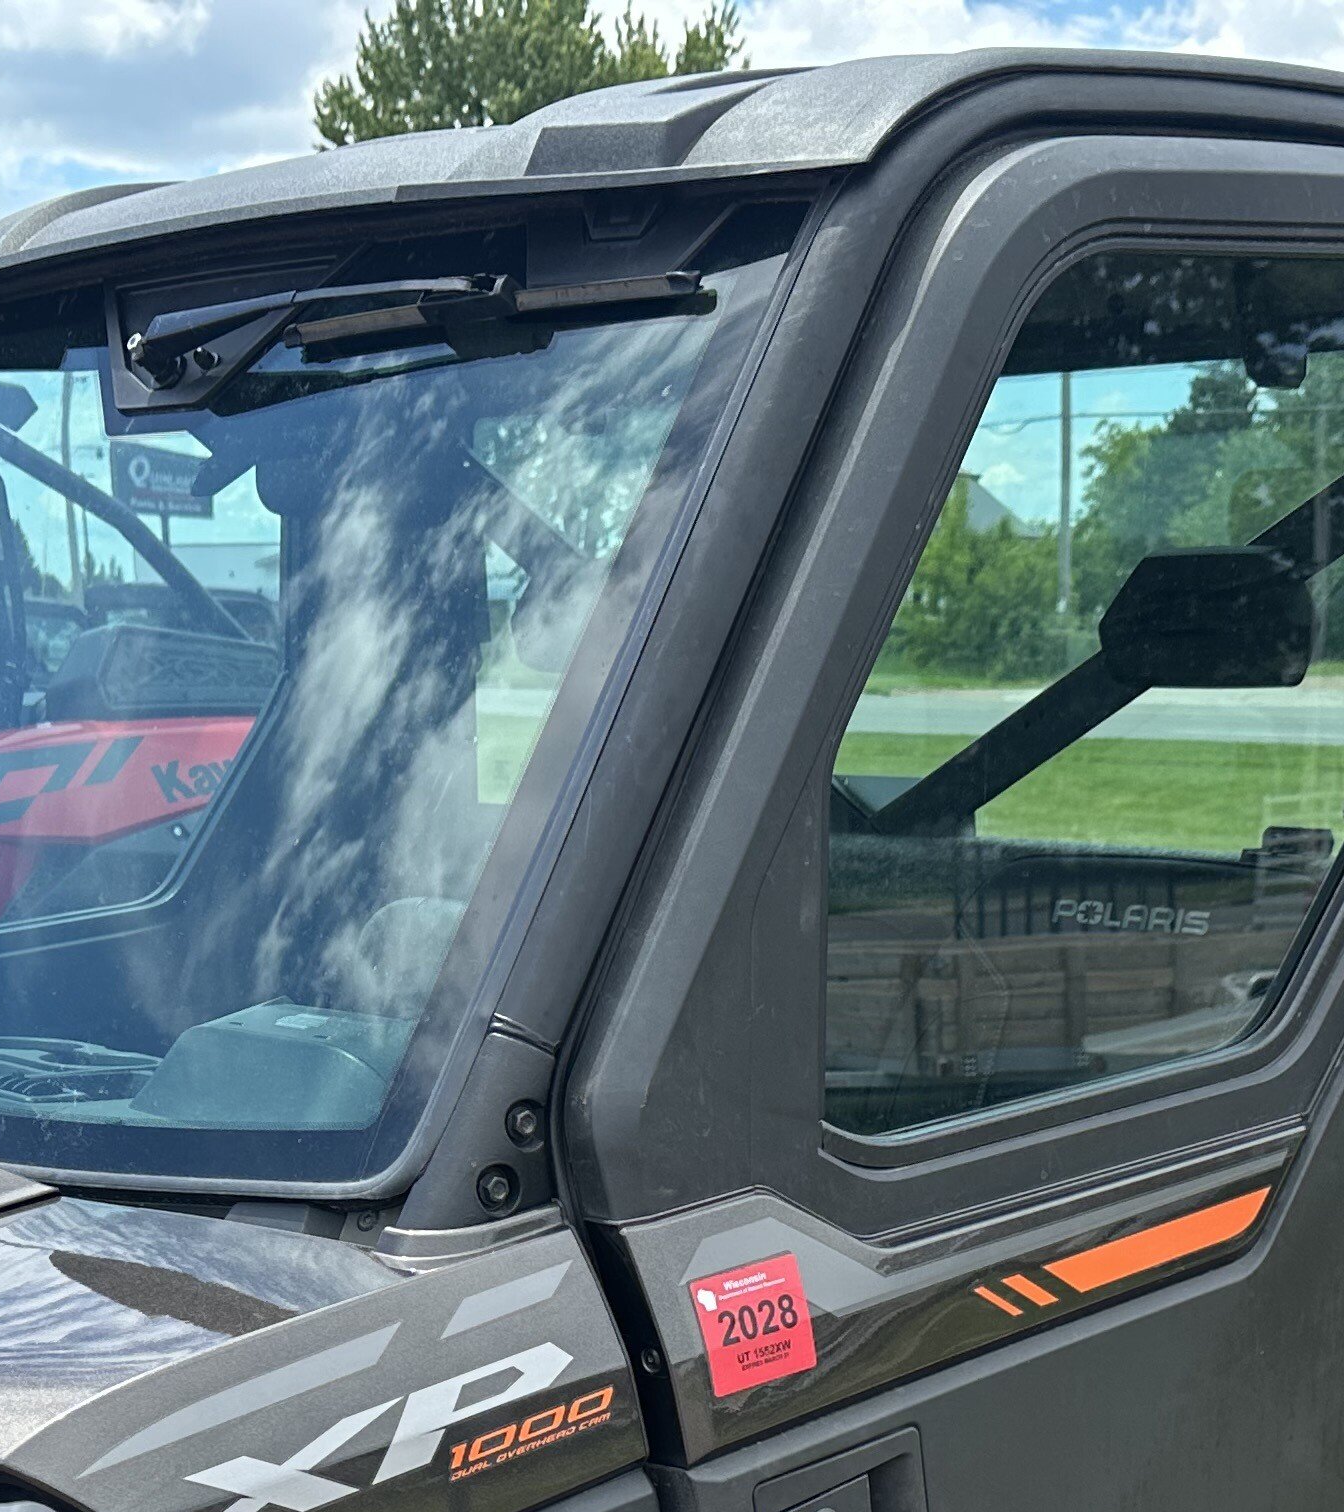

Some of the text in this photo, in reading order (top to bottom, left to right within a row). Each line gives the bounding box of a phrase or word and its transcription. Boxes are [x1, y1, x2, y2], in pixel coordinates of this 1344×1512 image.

[1052, 900, 1210, 936] POLARIS
[718, 1294, 798, 1347] 2028
[737, 1351, 751, 1364] UT
[450, 1385, 614, 1469] 1000
[451, 1412, 611, 1481] DUAL OVERHEAD CAM
